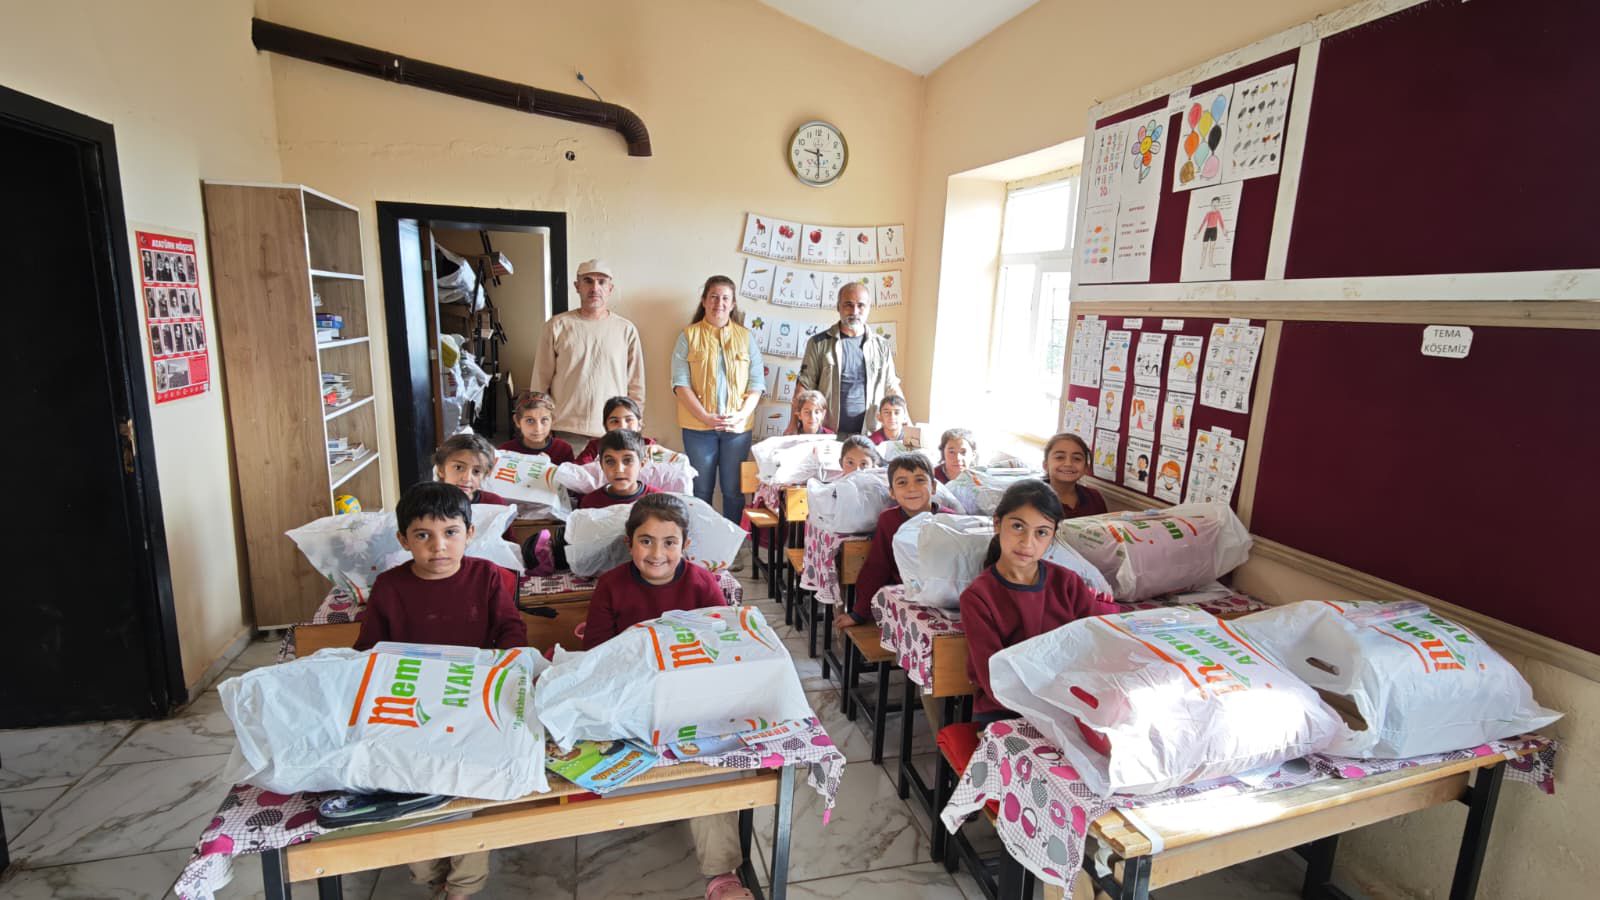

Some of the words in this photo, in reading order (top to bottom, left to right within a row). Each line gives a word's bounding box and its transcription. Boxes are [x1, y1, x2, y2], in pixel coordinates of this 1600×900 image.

[815, 128, 822, 137] 12
[798, 138, 805, 146] 10
[1433, 329, 1461, 338] TEMA
[1424, 343, 1467, 354] KÖŞEMİZ
[441, 662, 476, 708] AYAK
